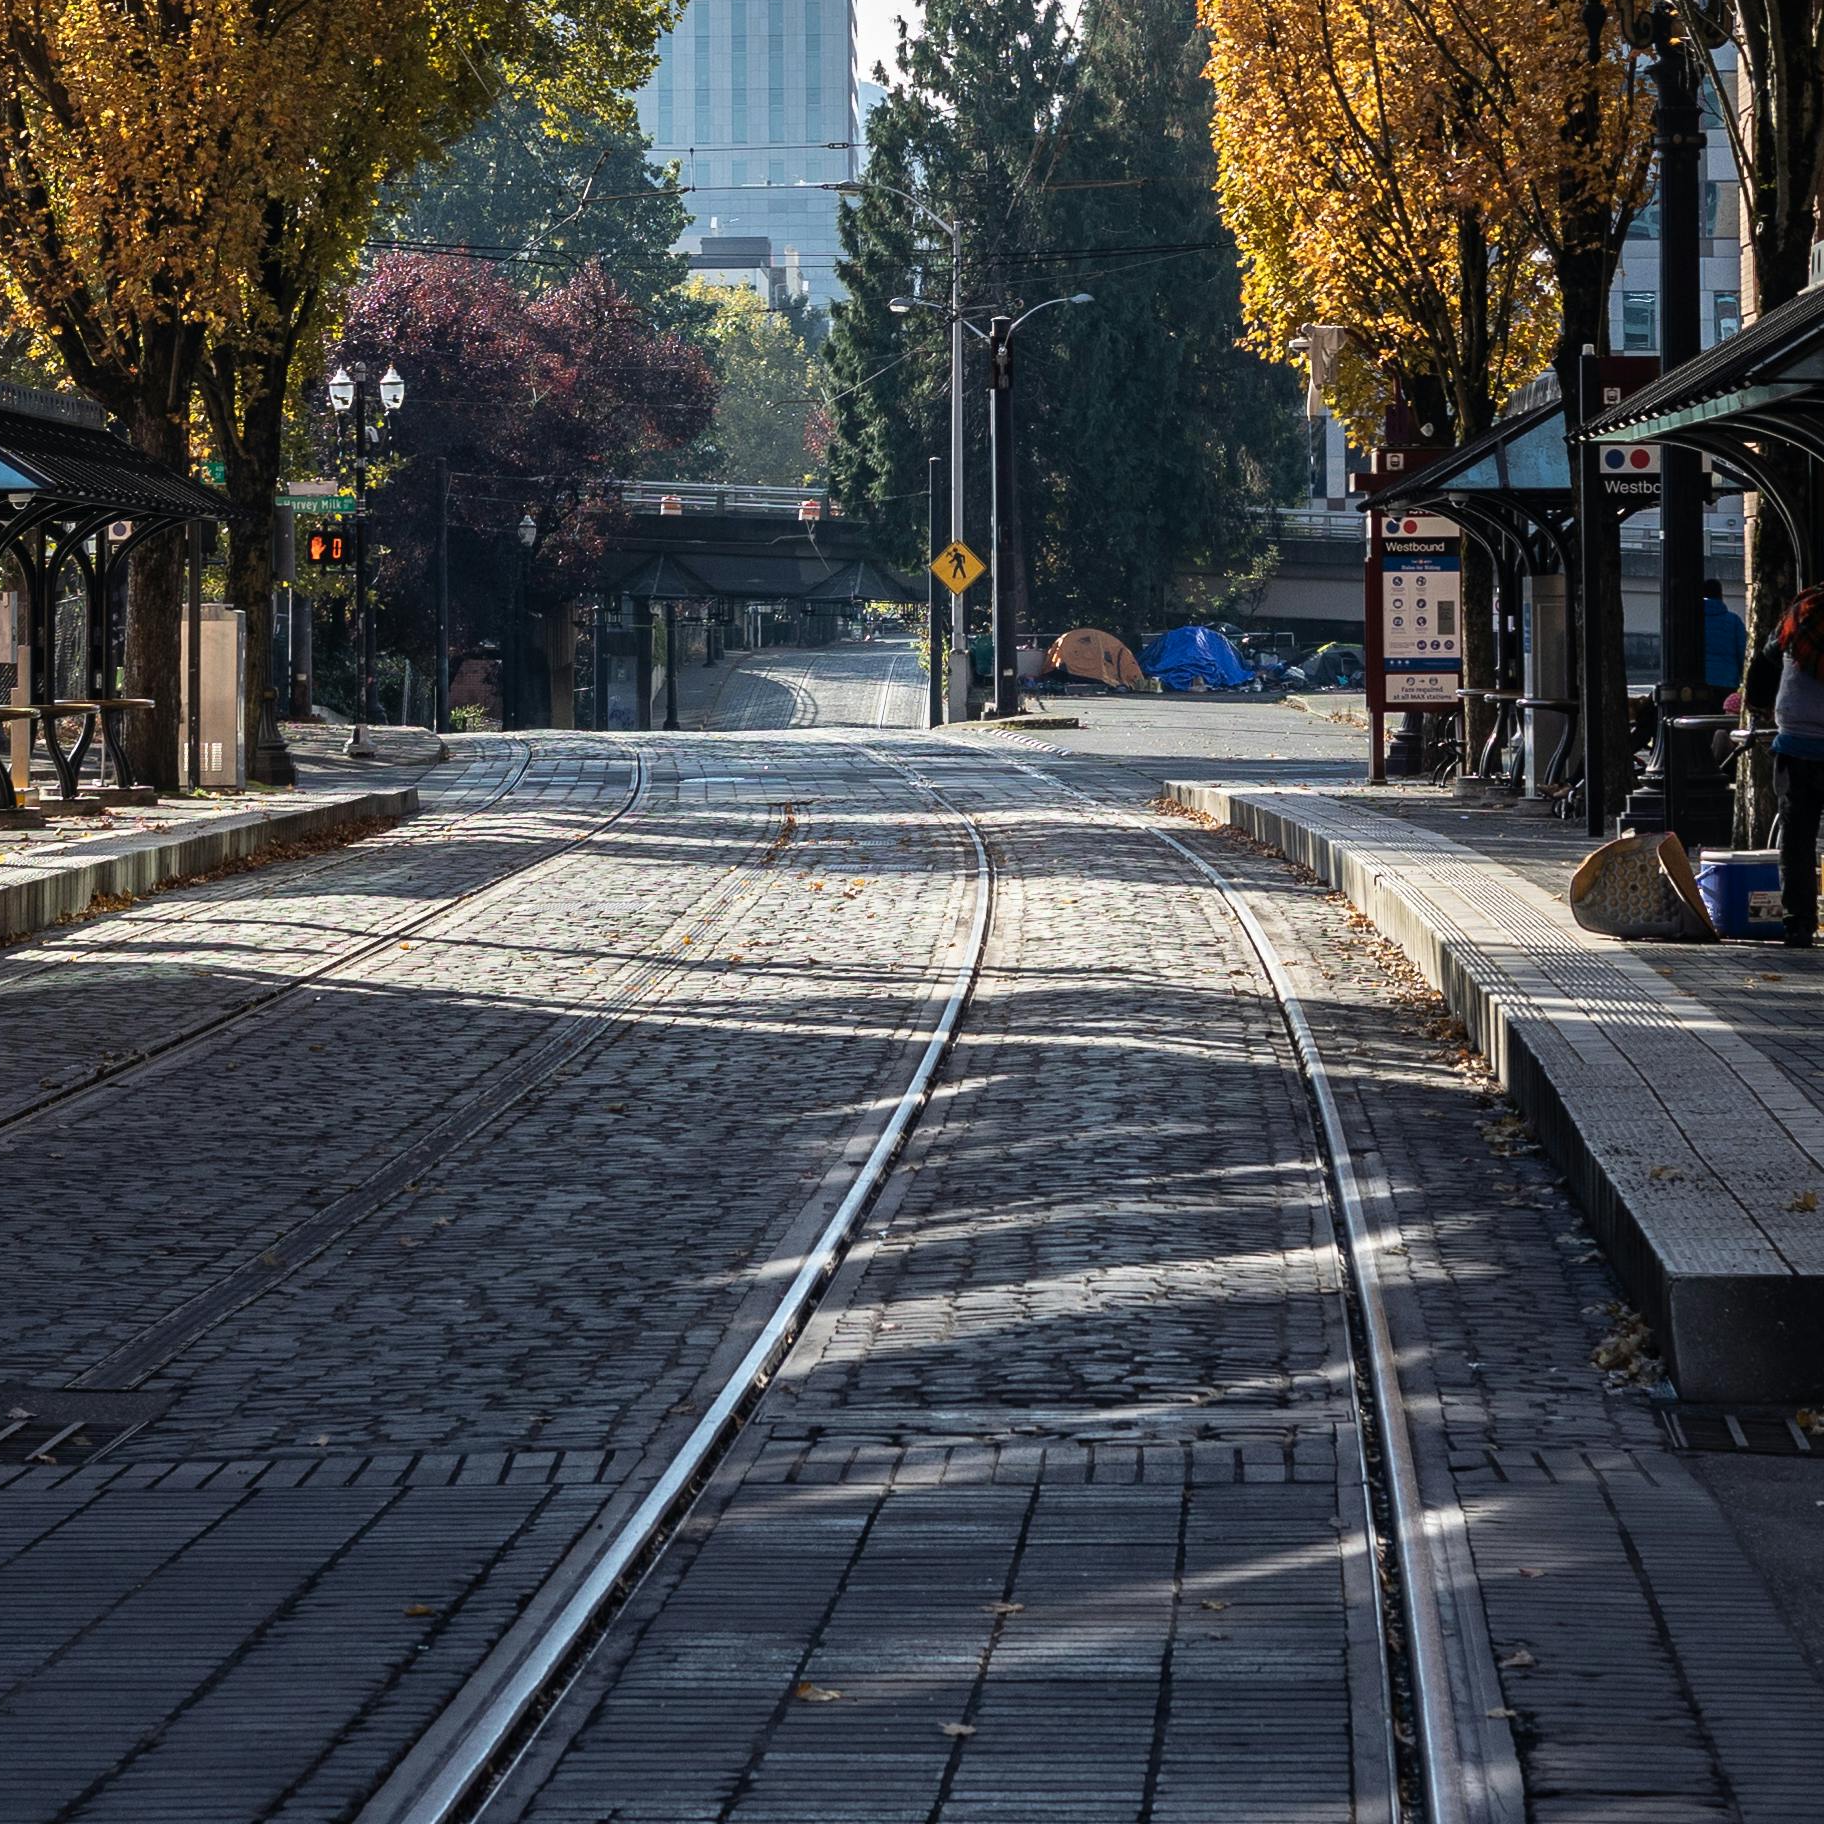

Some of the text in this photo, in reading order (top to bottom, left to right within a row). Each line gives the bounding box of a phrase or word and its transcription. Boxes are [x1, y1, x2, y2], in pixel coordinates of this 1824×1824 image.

[1604, 480, 1661, 494] Westbo
[321, 499, 342, 510] Milk
[1385, 541, 1445, 552] Westbound
